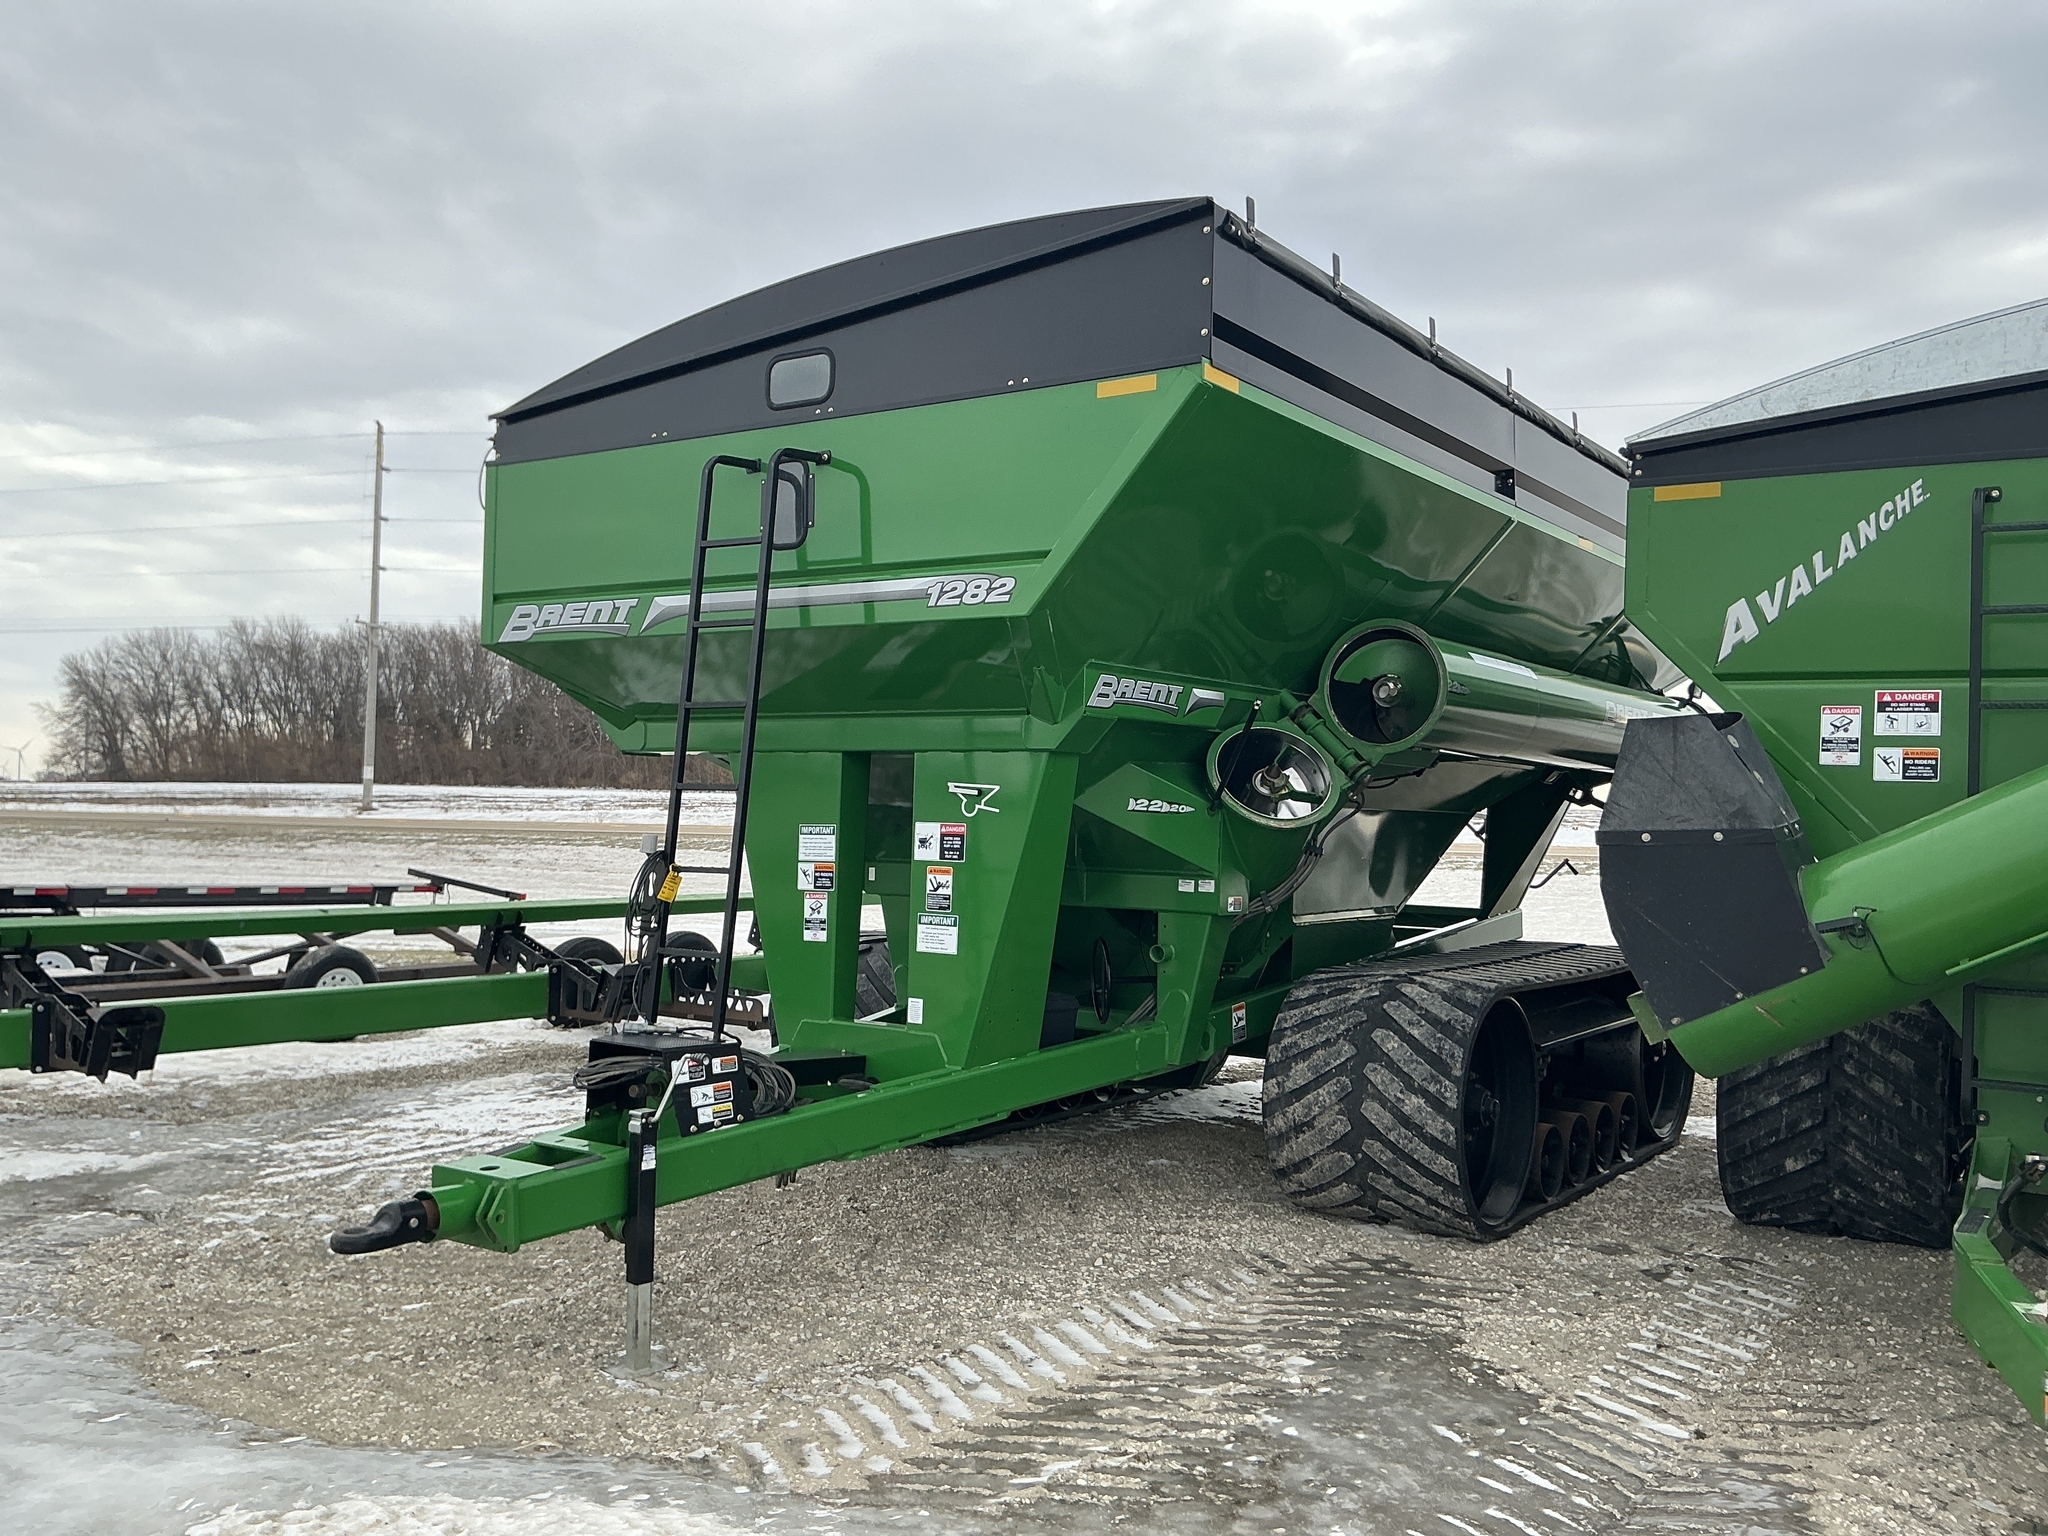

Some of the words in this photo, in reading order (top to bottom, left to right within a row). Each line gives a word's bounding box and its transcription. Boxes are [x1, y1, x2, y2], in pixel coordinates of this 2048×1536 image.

[1715, 477, 1924, 667] AVALANCHE
[927, 576, 1017, 608] 1282
[498, 598, 639, 643] BRENT
[1086, 673, 1184, 709] BRENT
[1895, 693, 1935, 701] DANGER
[801, 826, 834, 835] IMPORTANT
[920, 915, 955, 926] IMPORTANT
